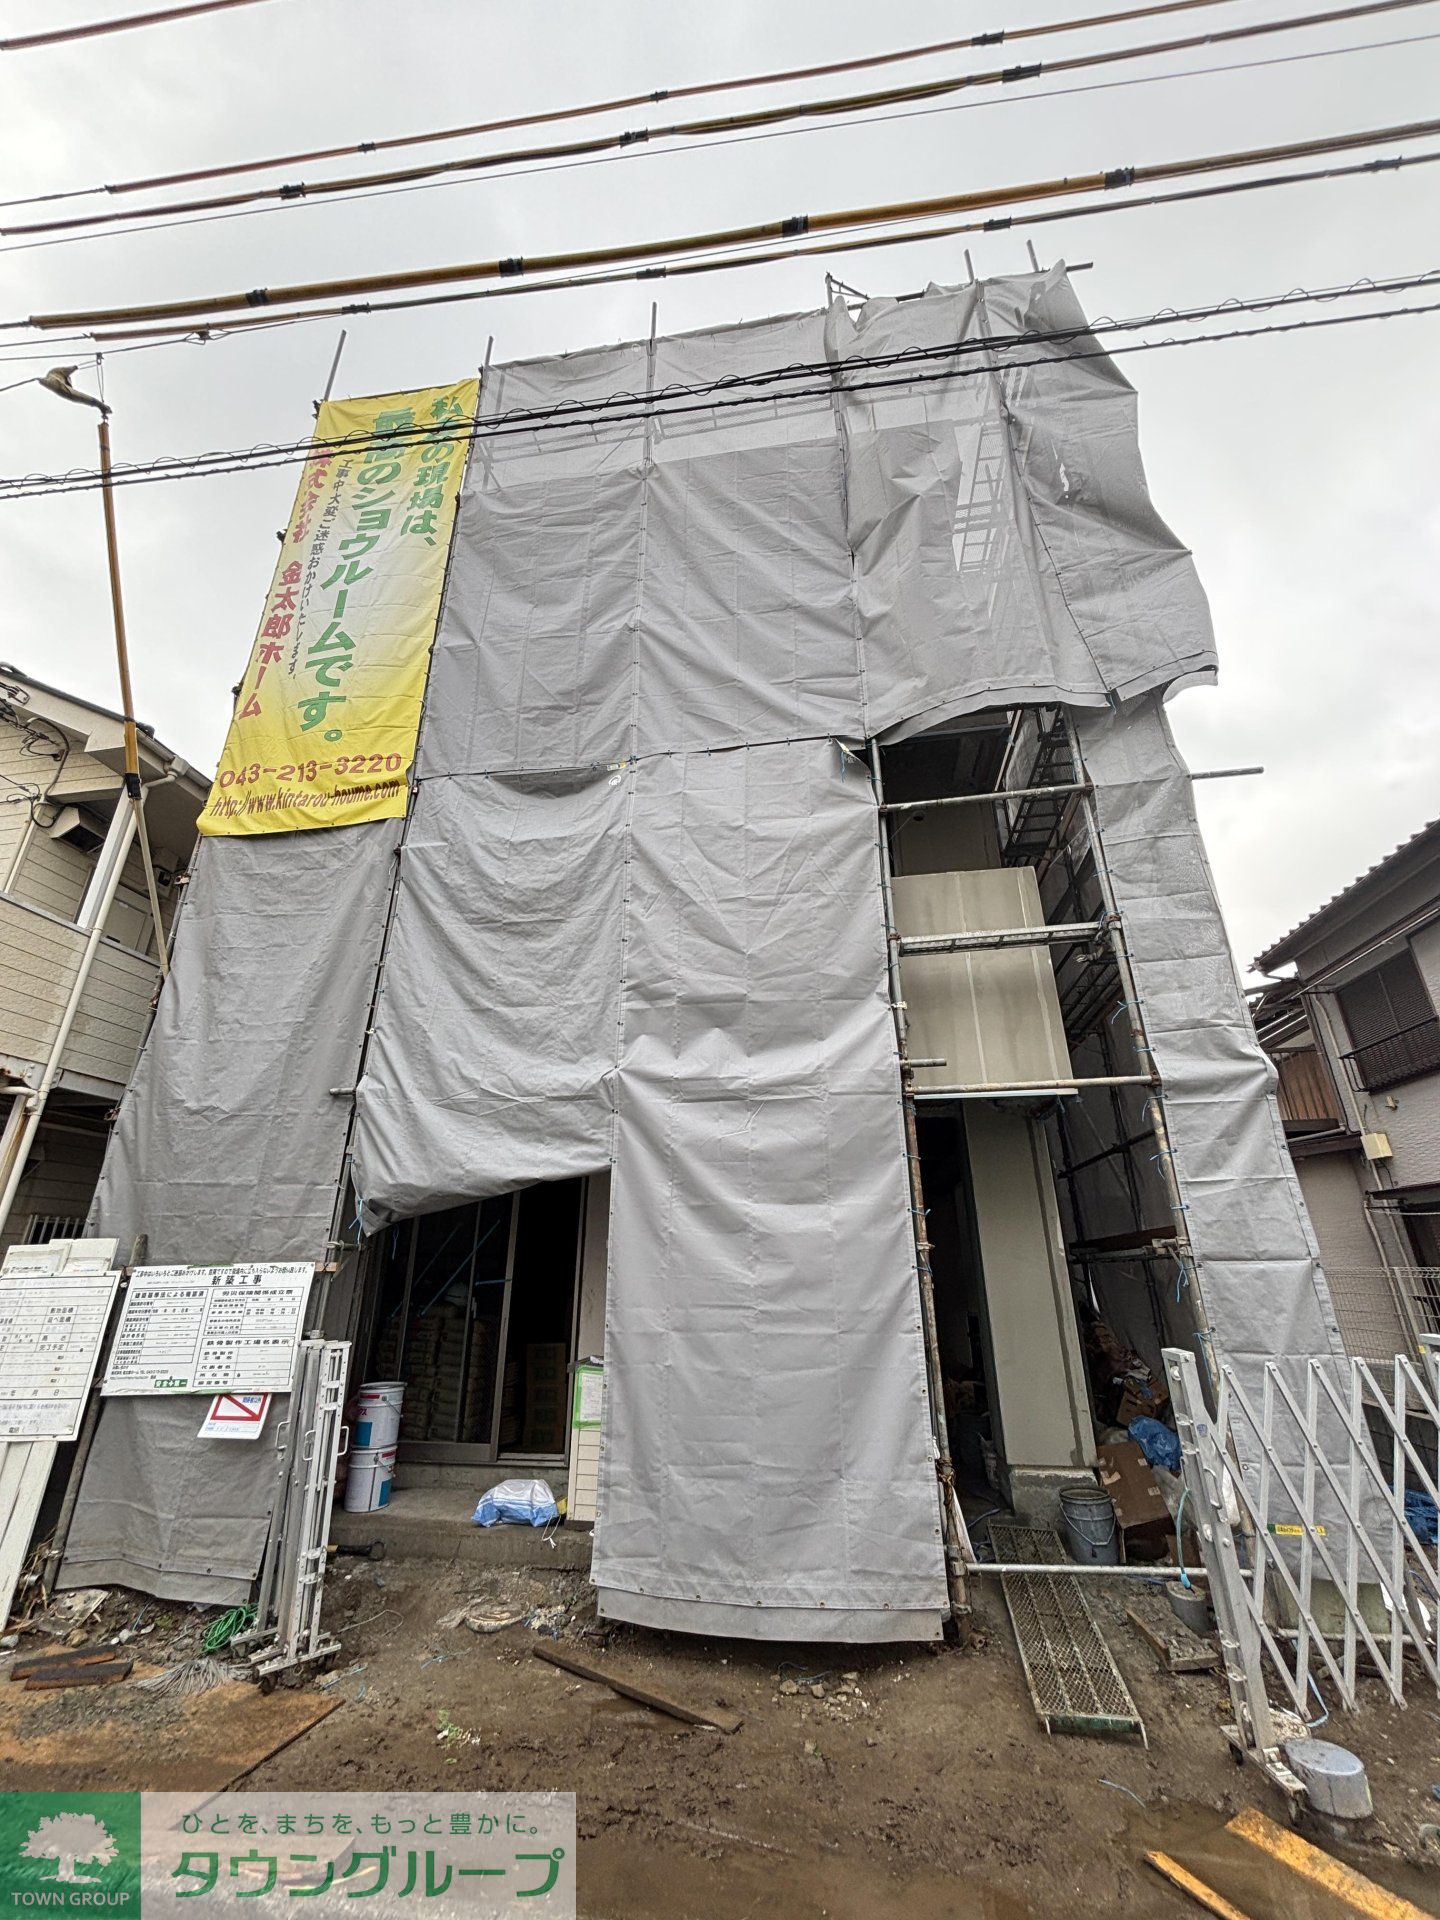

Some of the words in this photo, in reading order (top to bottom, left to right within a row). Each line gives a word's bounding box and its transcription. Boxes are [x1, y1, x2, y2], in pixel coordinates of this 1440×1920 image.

[238, 560, 303, 720] 金太郎ホーム
[219, 752, 402, 788] 043-213-3220
[211, 1274, 262, 1285] 新築工事
